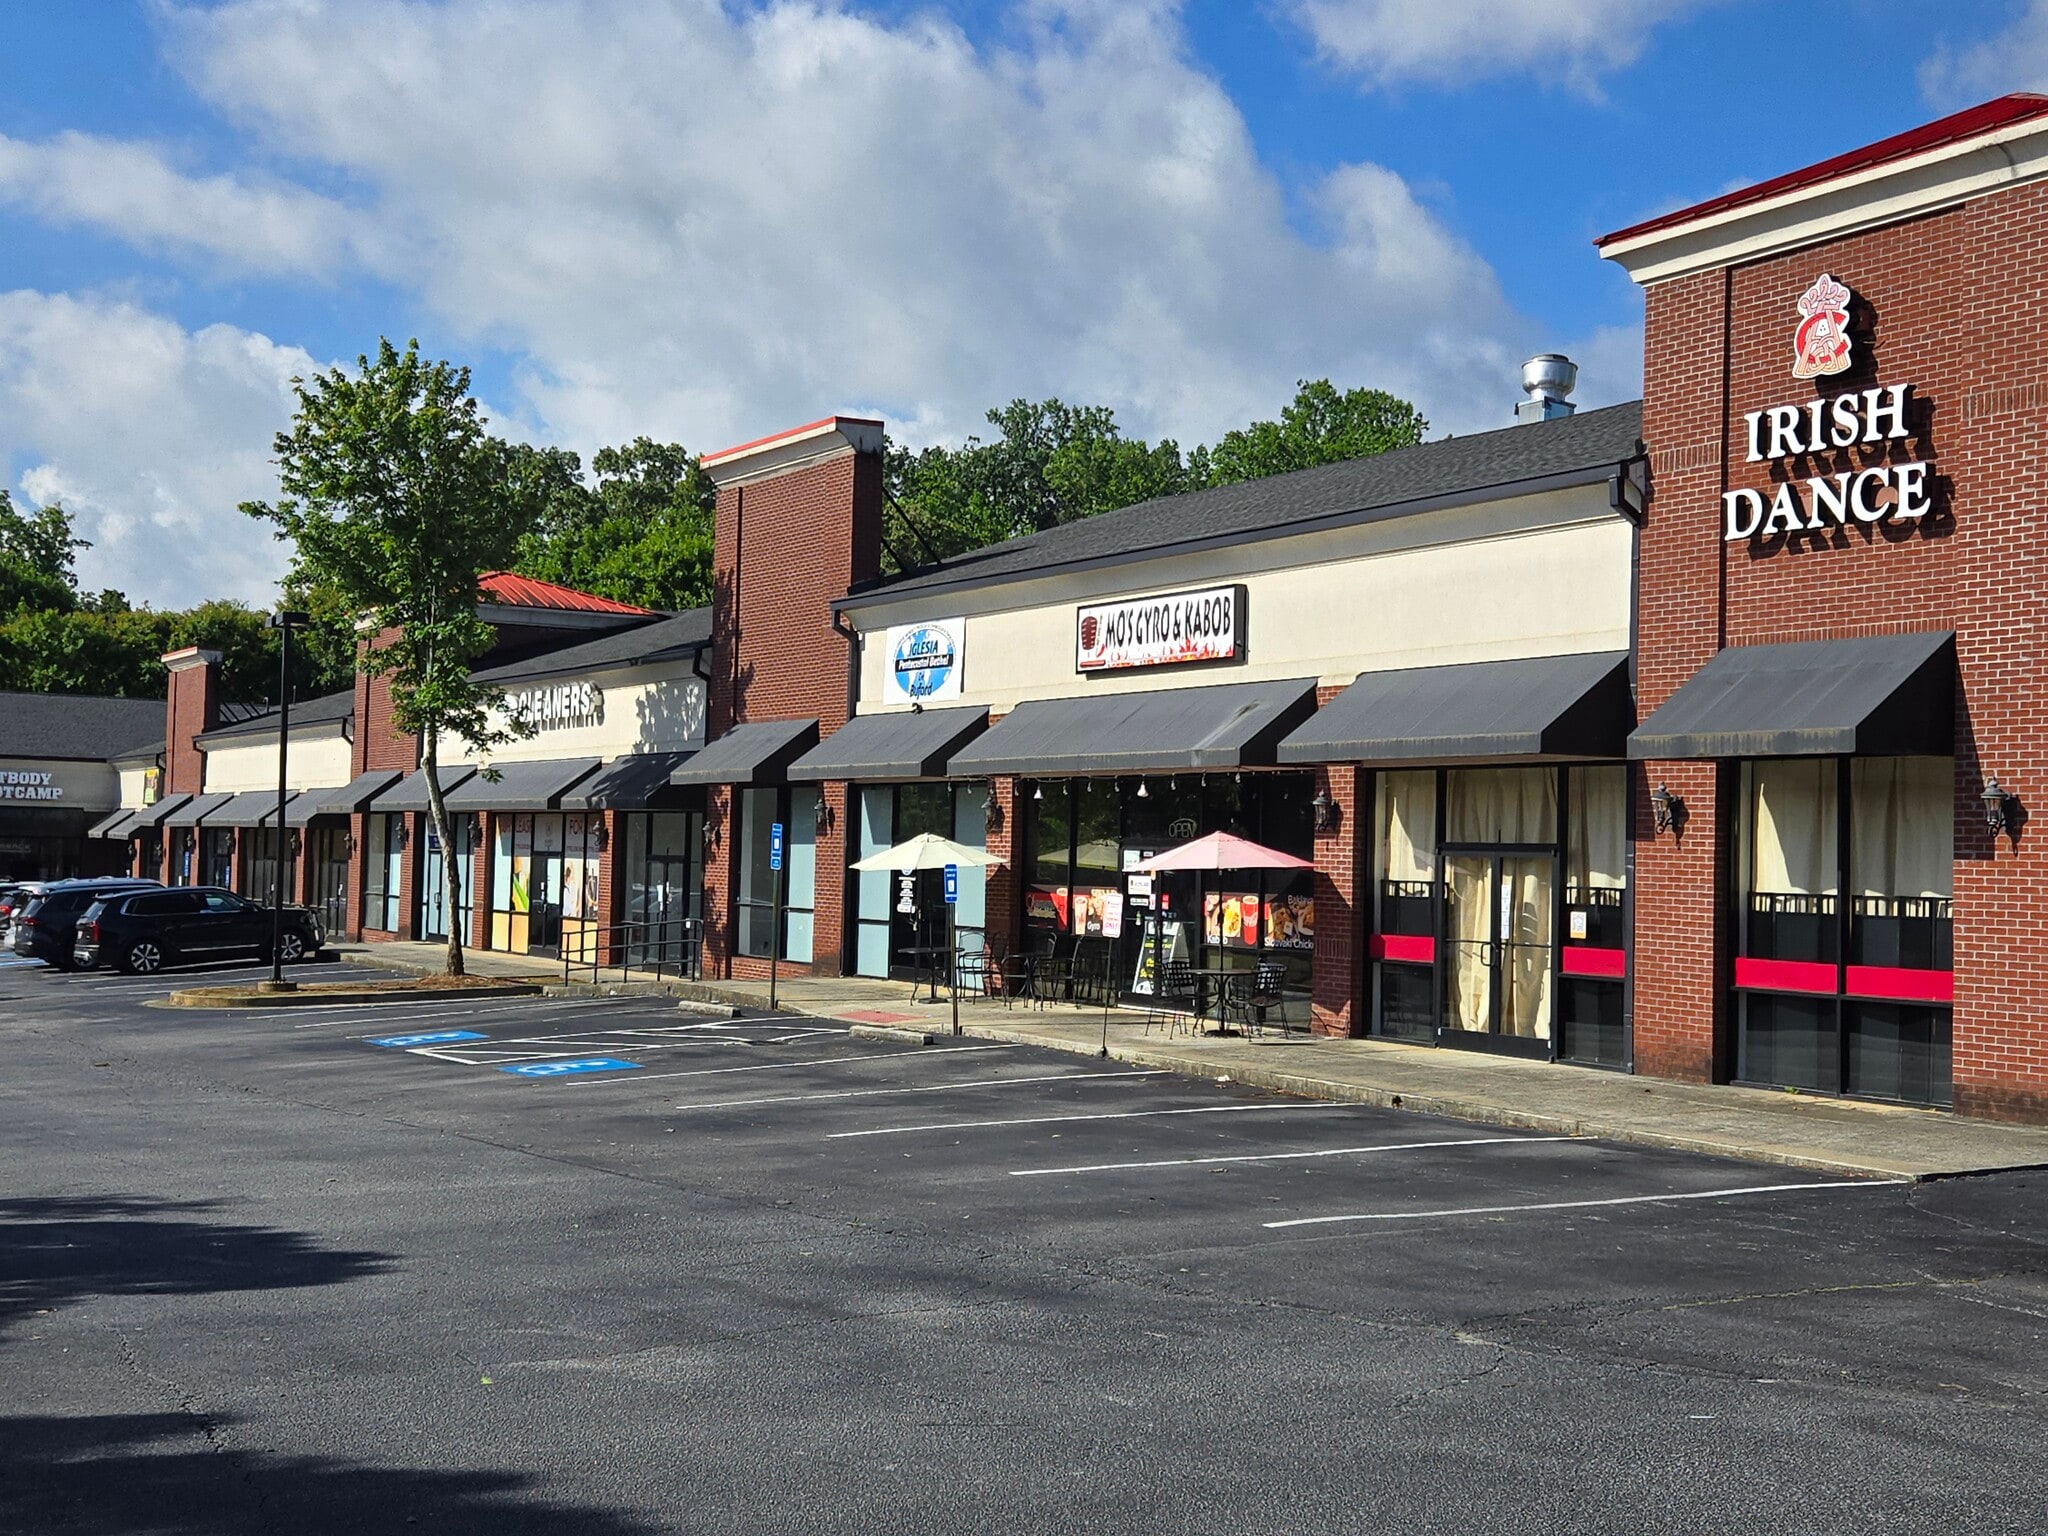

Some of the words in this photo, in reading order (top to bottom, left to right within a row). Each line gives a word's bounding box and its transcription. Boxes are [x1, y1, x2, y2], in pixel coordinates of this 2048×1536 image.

[1744, 383, 1909, 463] IRISH
[1722, 462, 1931, 541] DANCE
[1106, 608, 1132, 648] MO'S
[1136, 603, 1170, 645] GYRO
[1173, 602, 1181, 641] &
[1185, 596, 1231, 639] KABOB
[909, 640, 938, 656] IGLESIA
[519, 683, 592, 723] CLEANERS
[909, 682, 933, 700] Buford
[0, 786, 63, 800] TCAMP
[1169, 822, 1196, 838] OPEN
